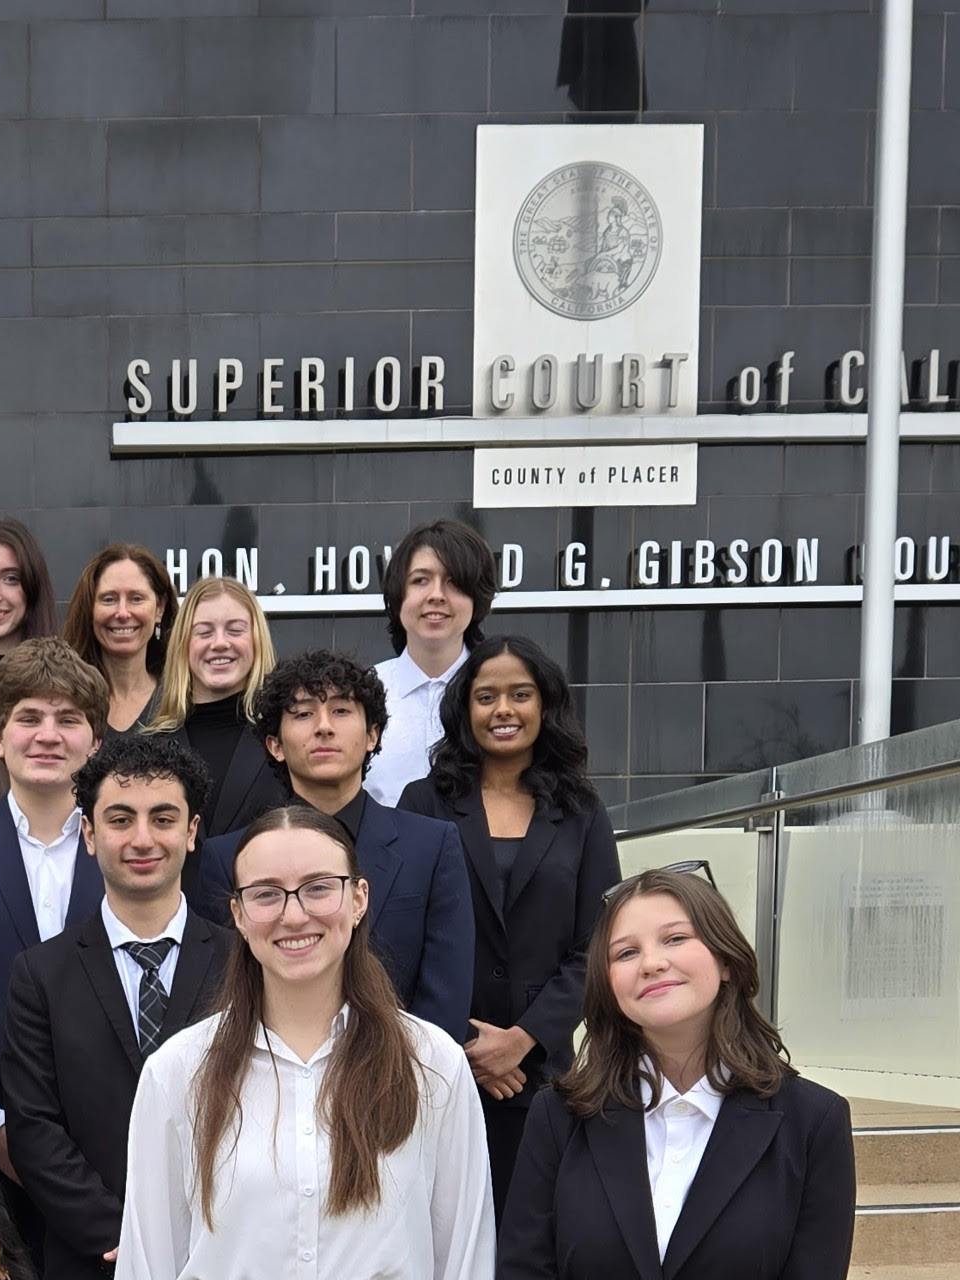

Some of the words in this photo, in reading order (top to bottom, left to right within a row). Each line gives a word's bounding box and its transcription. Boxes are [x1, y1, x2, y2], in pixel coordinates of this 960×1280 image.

[612, 171, 633, 191] THE
[522, 185, 549, 222] GREAT
[634, 188, 657, 230] STATE
[519, 231, 528, 255] THE
[649, 235, 658, 252] OF
[550, 297, 627, 315] CALIFORNIA
[127, 355, 446, 415] SUPERIOR
[491, 352, 689, 411] COURT
[739, 350, 796, 406] of
[492, 467, 567, 486] COUNTY
[578, 467, 597, 484] of
[608, 465, 680, 484] PLACER
[166, 546, 286, 595] HON.
[315, 543, 525, 593] HOD
[564, 541, 611, 588] G.
[638, 537, 819, 585] GIBSON
[861, 535, 951, 582] OU
